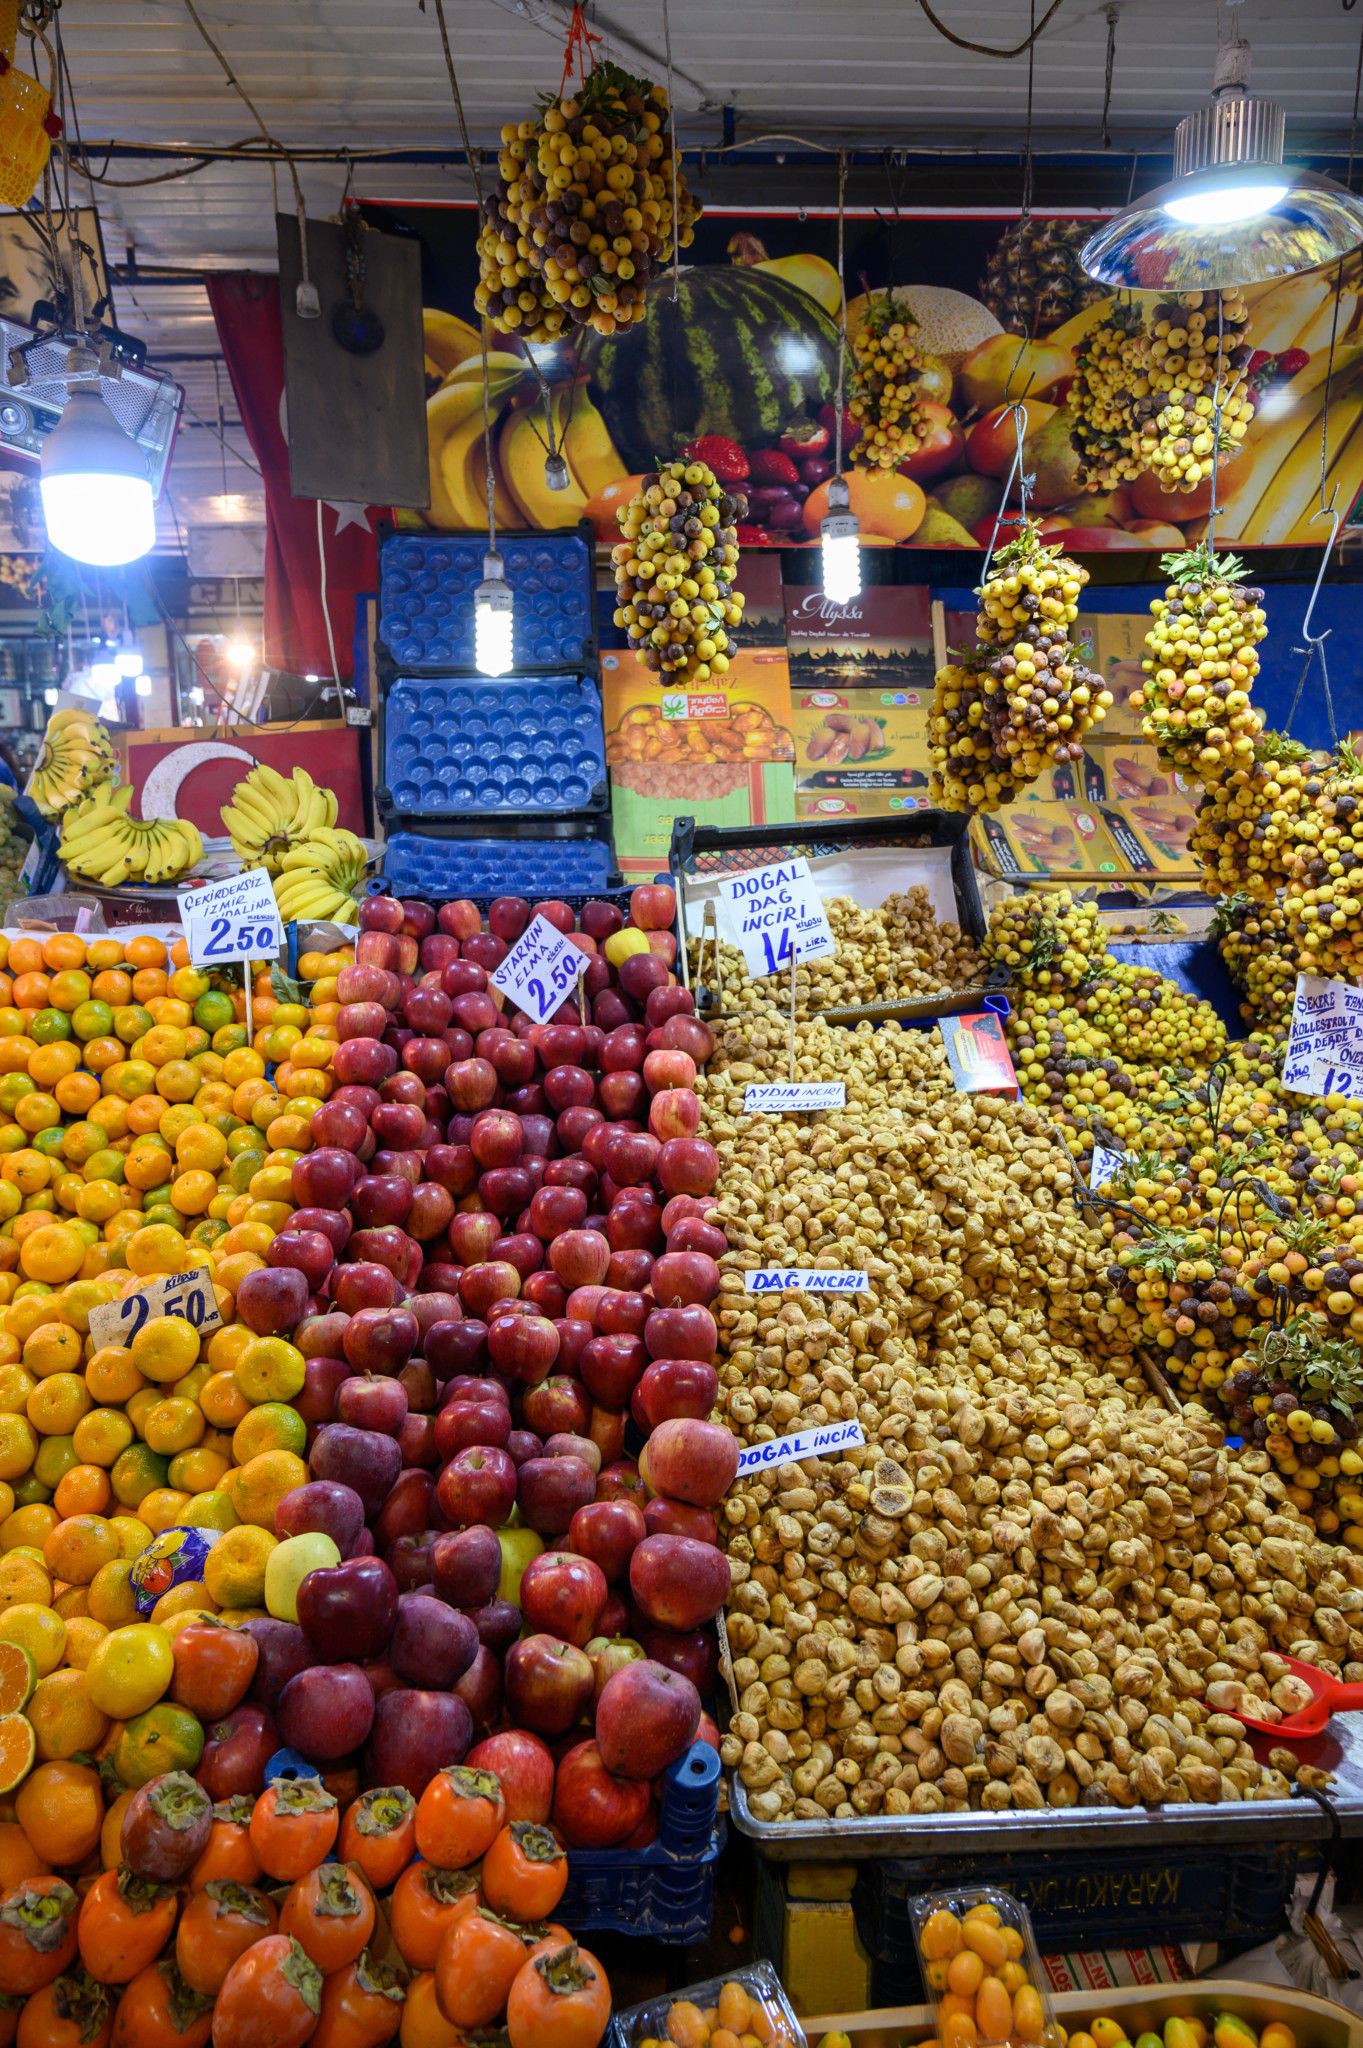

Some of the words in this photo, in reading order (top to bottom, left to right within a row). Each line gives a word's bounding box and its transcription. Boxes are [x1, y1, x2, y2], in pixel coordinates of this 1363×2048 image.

[730, 864, 805, 900] DOĞAL
[748, 888, 793, 914] DAĞ
[514, 944, 550, 990] ELMA
[1288, 1039, 1312, 1057] HER
[745, 1087, 800, 1099] AYDIN
[751, 1271, 800, 1290] DAĞ
[813, 1423, 860, 1448] İNCİR
